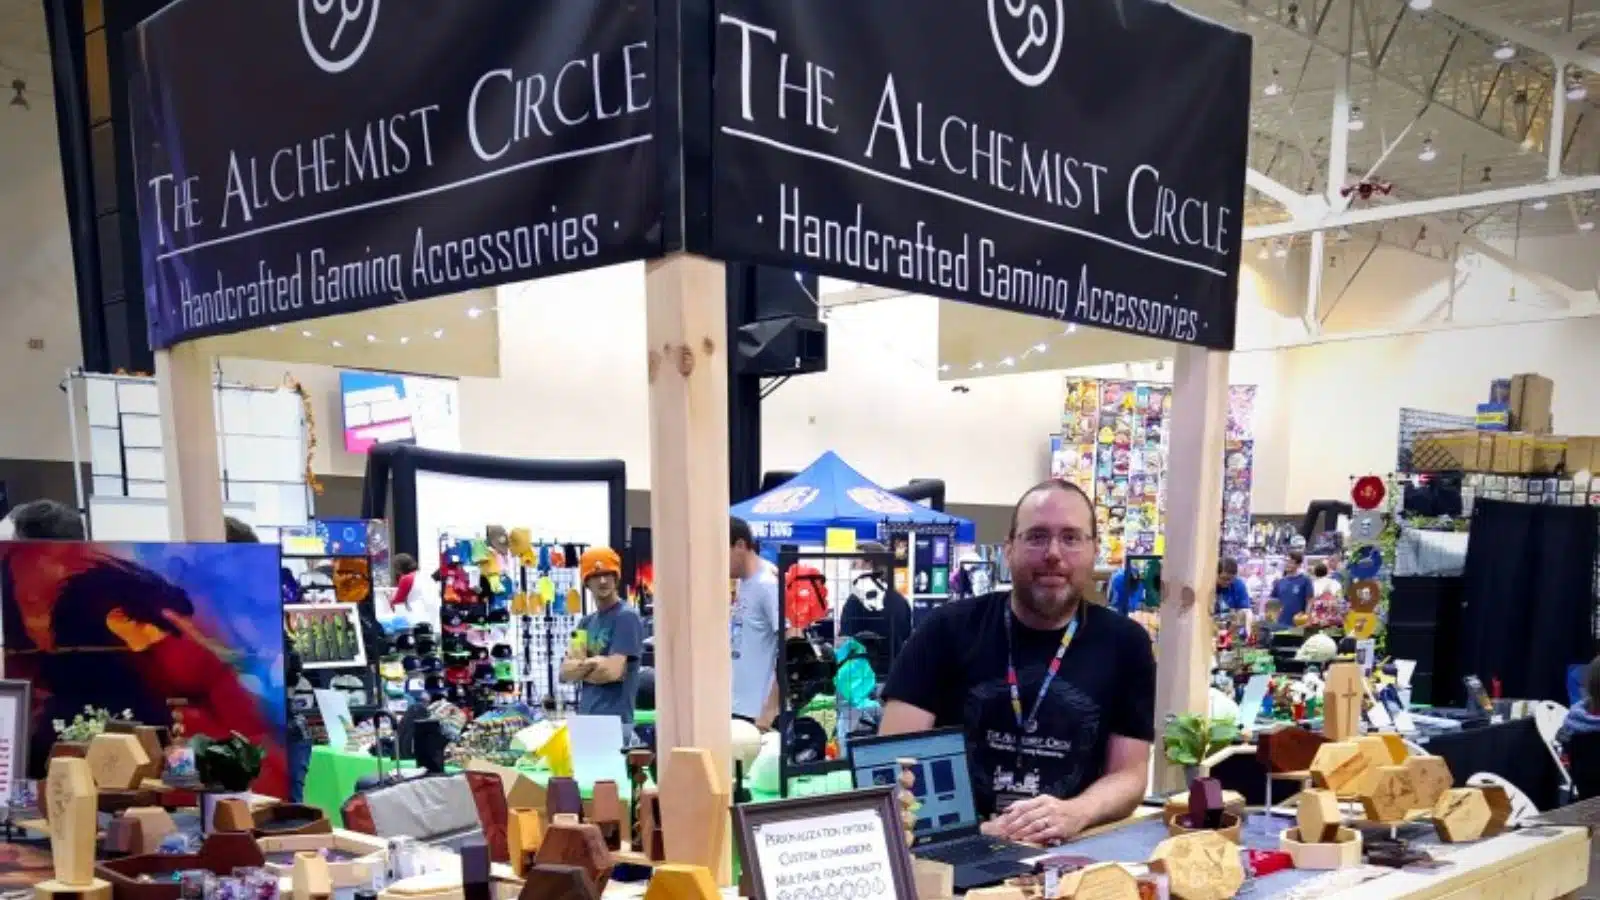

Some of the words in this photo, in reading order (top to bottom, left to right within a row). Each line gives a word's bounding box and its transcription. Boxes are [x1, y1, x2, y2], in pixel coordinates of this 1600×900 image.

[149, 173, 202, 246] THE
[221, 104, 440, 230] ALCHEMIST
[467, 40, 653, 162] CIRCLE
[719, 13, 840, 135] THE
[863, 72, 1108, 217] ALCHEMIST
[1126, 163, 1232, 257] CIRCLE
[180, 260, 302, 330] Handcrafted
[310, 245, 402, 306] Gaming
[411, 205, 600, 288] Accessories
[778, 183, 969, 291] Handcrafted
[978, 238, 1068, 318] Gaming
[1076, 263, 1199, 341] Accessories
